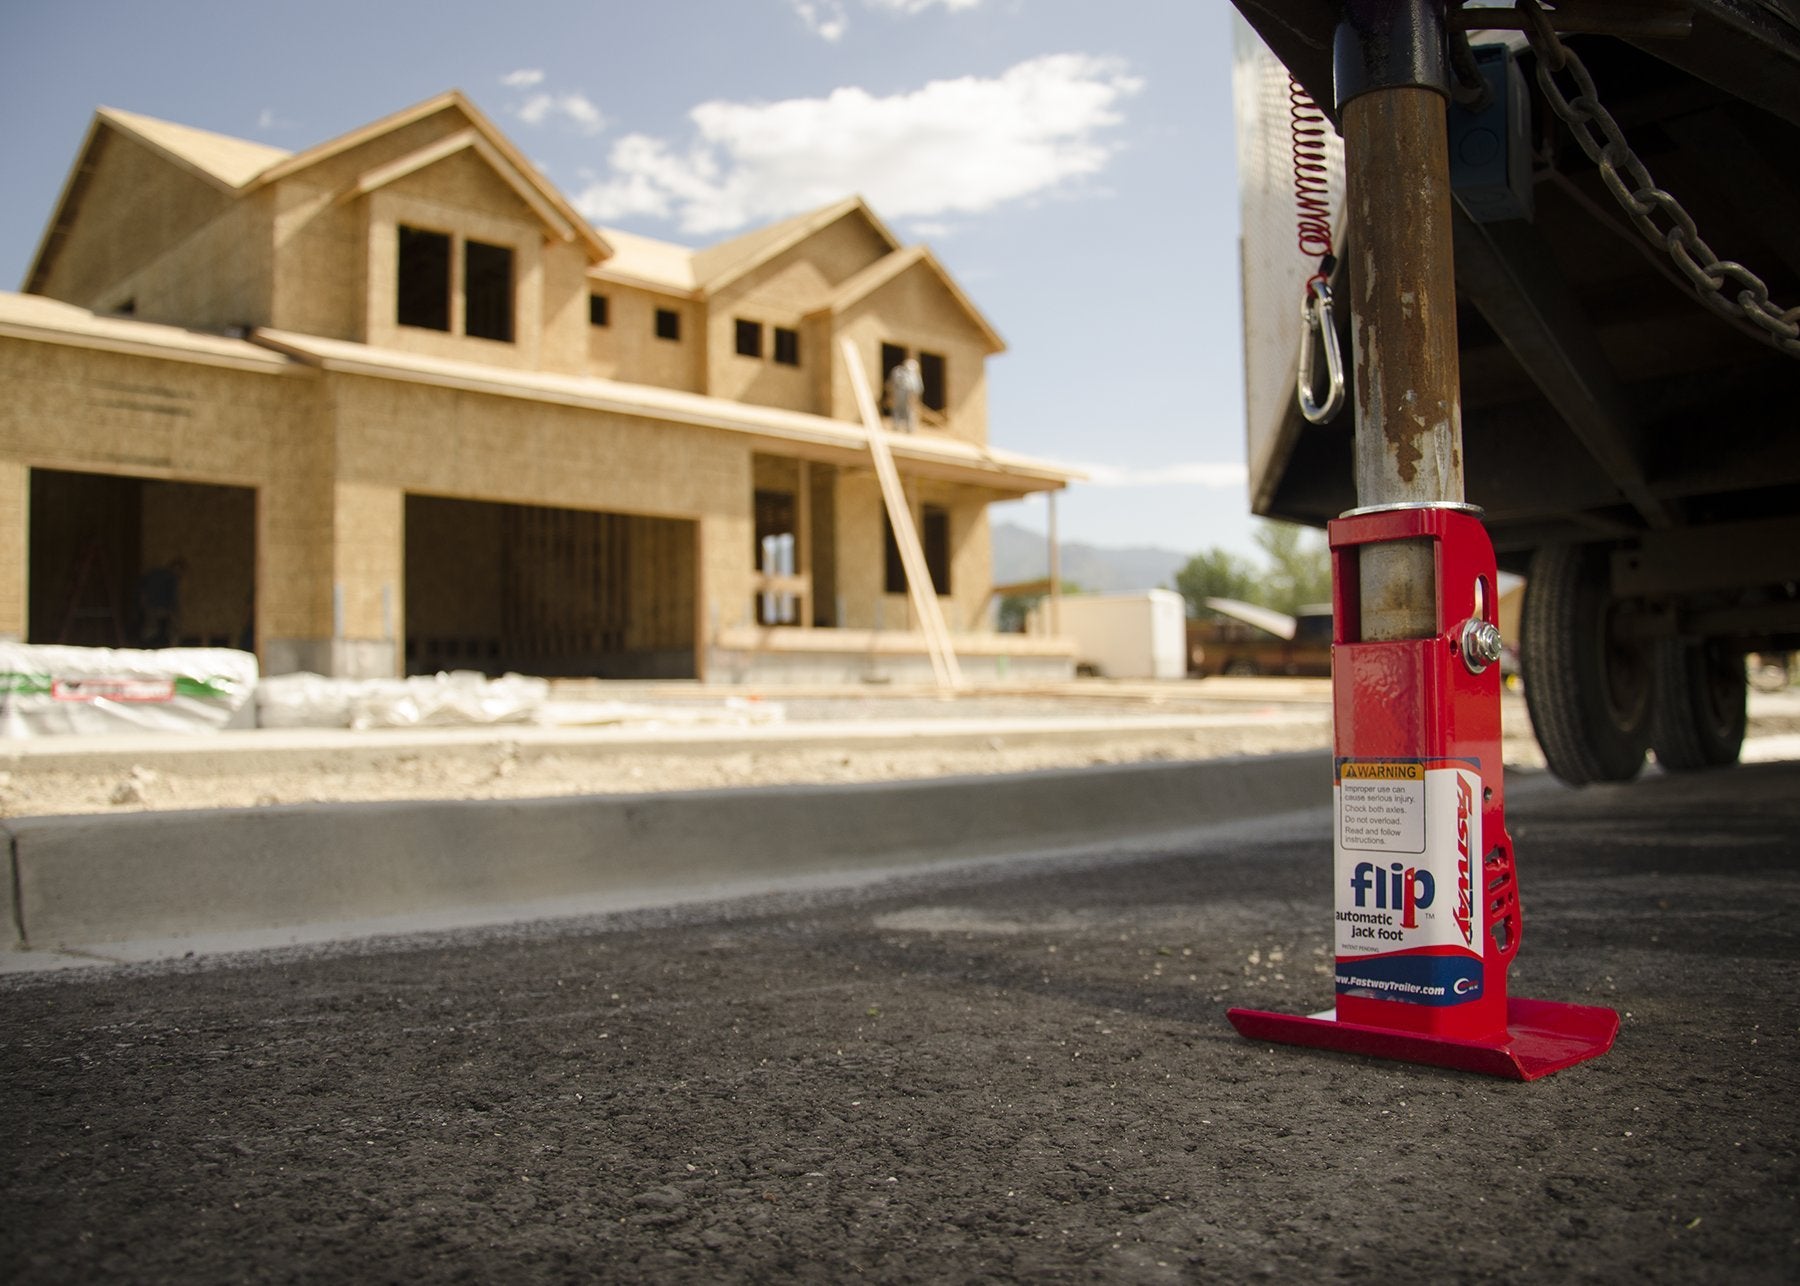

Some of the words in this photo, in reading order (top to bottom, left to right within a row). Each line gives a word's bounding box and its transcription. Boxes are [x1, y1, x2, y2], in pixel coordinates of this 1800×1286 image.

[1357, 766, 1416, 778] WARNING
[1345, 785, 1375, 793] Improper
[1392, 786, 1406, 794] can
[1394, 795, 1415, 804] injury.
[1345, 804, 1367, 813] Chock
[1386, 806, 1407, 814] axles.
[1345, 815, 1355, 823] Do
[1369, 816, 1402, 825] overload.
[1345, 826, 1364, 835] Read
[1345, 837, 1386, 845] instructions.
[1453, 770, 1473, 947] FASTWAY
[1351, 862, 1435, 929] flip
[1351, 925, 1375, 938] jack
[1378, 928, 1403, 941] foot
